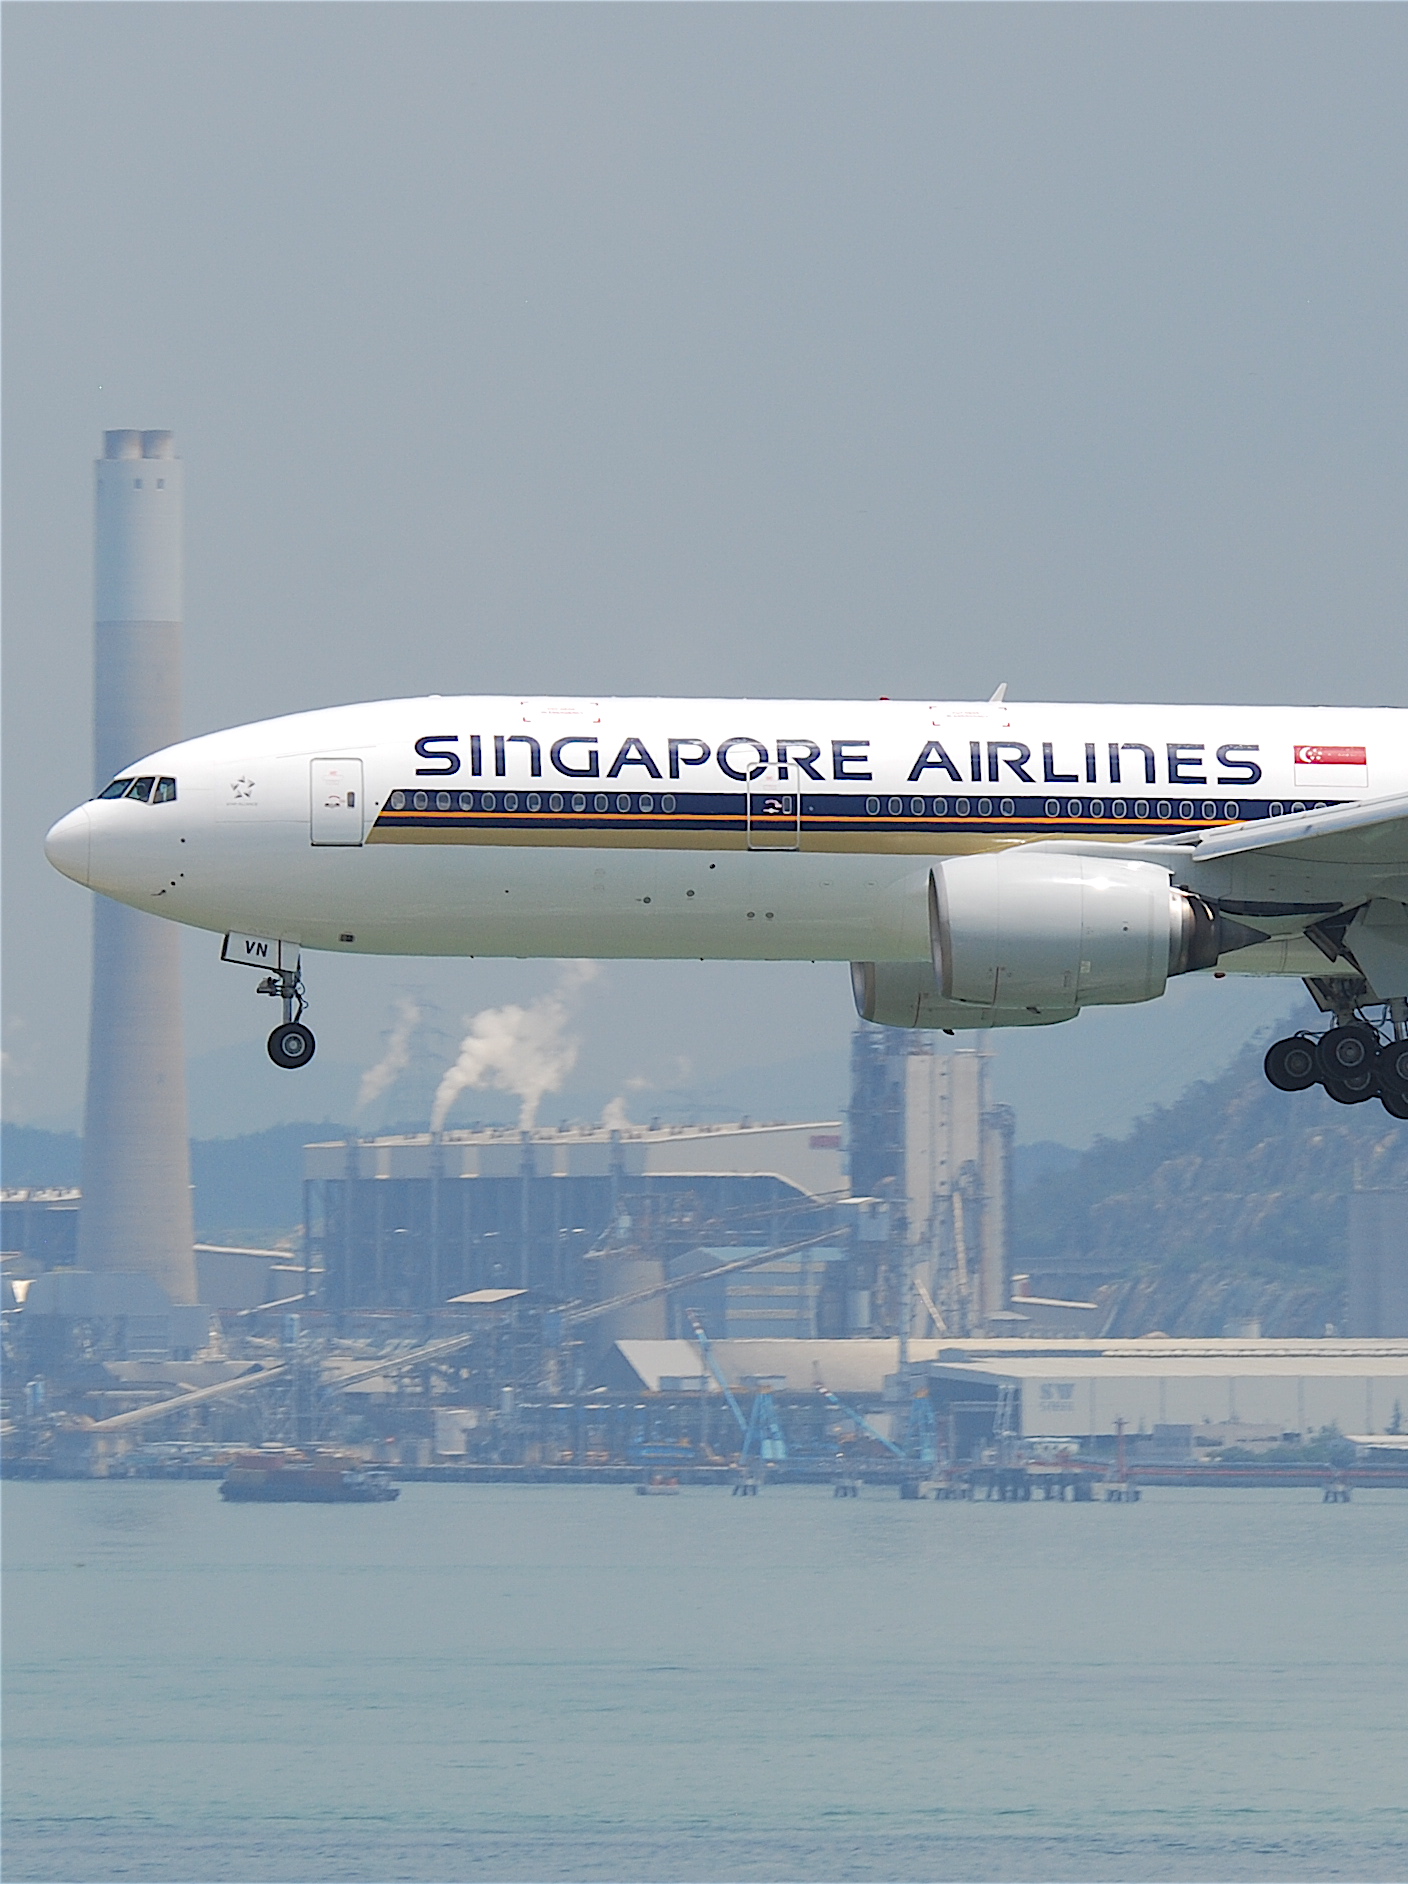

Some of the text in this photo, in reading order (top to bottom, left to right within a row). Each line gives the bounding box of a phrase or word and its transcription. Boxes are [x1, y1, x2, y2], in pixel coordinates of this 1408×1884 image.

[414, 735, 1262, 784] SINGAPORE AIRLINES
[245, 940, 268, 957] VN
